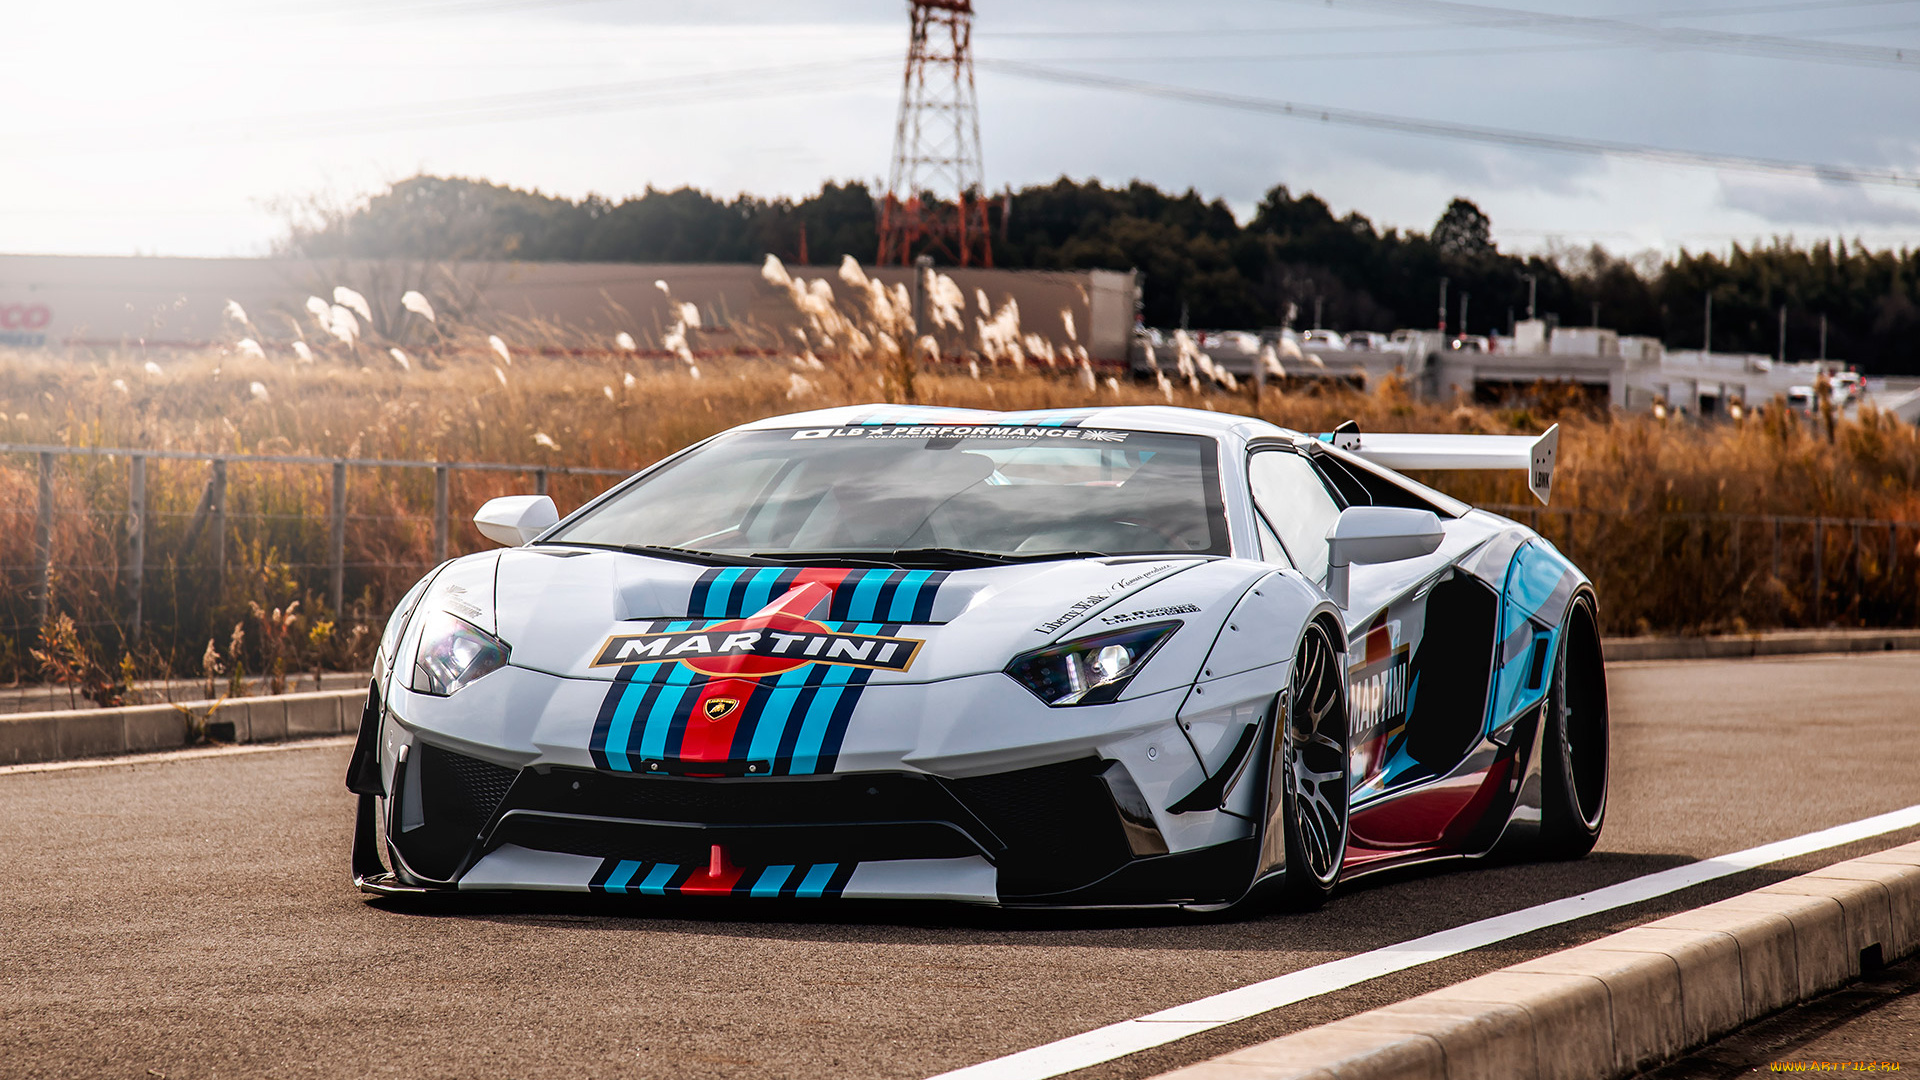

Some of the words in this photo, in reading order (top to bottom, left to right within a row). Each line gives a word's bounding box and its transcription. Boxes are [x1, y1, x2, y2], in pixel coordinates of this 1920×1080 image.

[832, 427, 866, 437] LB
[890, 426, 1082, 439] PERFORMANCE
[1106, 612, 1165, 625] LIMITED
[615, 631, 901, 663] MARTINI
[1350, 662, 1407, 737] MARTINI
